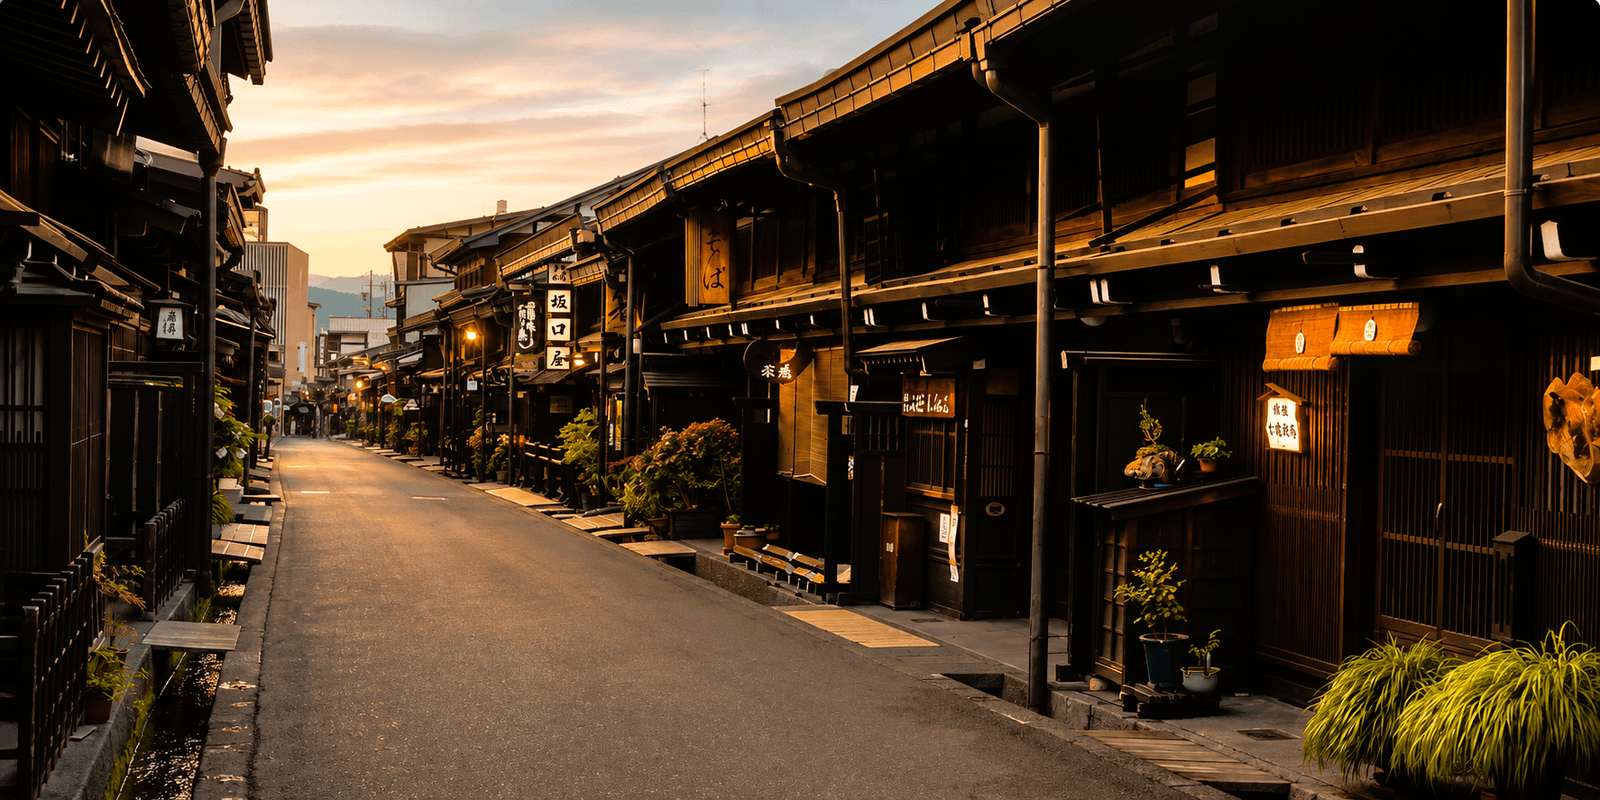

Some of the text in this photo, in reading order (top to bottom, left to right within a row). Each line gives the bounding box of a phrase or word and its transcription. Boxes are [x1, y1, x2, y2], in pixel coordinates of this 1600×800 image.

[703, 228, 725, 290] そば
[551, 294, 569, 366] 坂口屋
